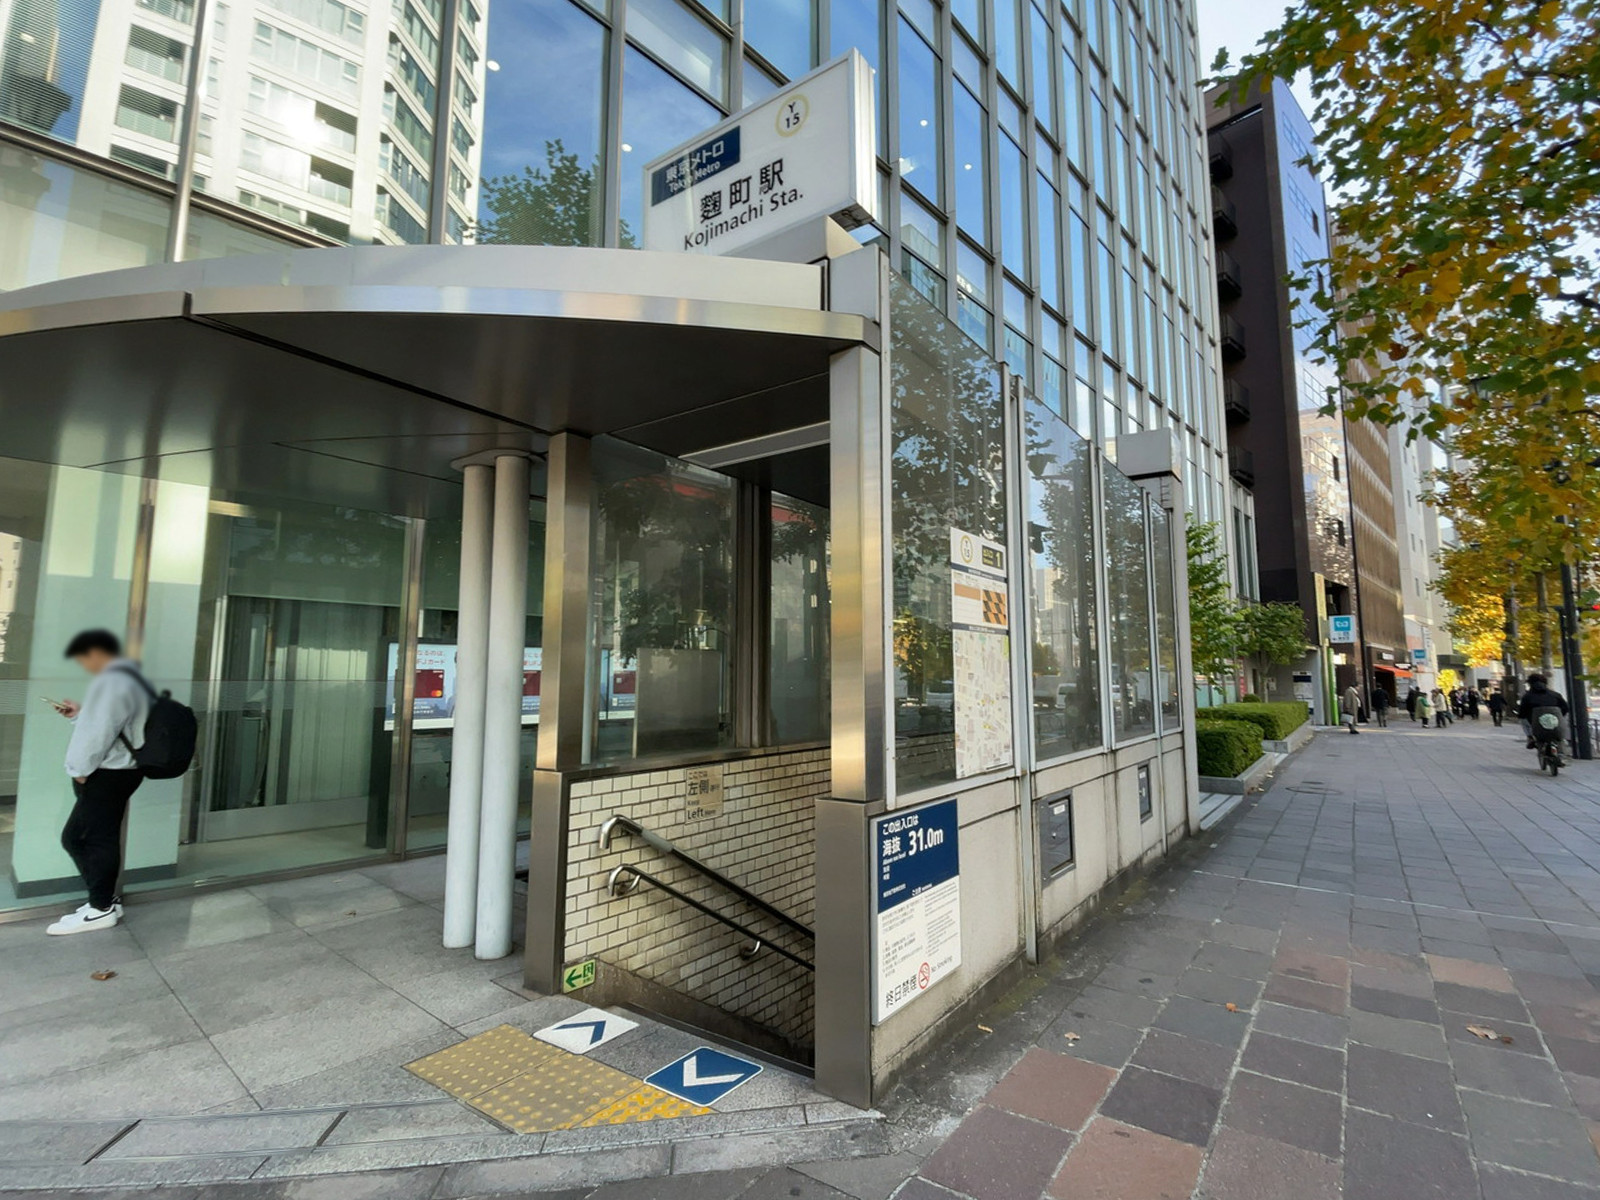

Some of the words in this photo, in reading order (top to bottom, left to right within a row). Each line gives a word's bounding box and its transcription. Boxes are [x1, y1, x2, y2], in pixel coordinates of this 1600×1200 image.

[788, 102, 797, 114] Y
[785, 113, 801, 129] 15
[694, 161, 721, 180] Metro
[684, 201, 764, 251] Kojimachi
[769, 187, 804, 212] Sta.
[687, 807, 704, 820] Left
[908, 827, 944, 856] 31.0m
